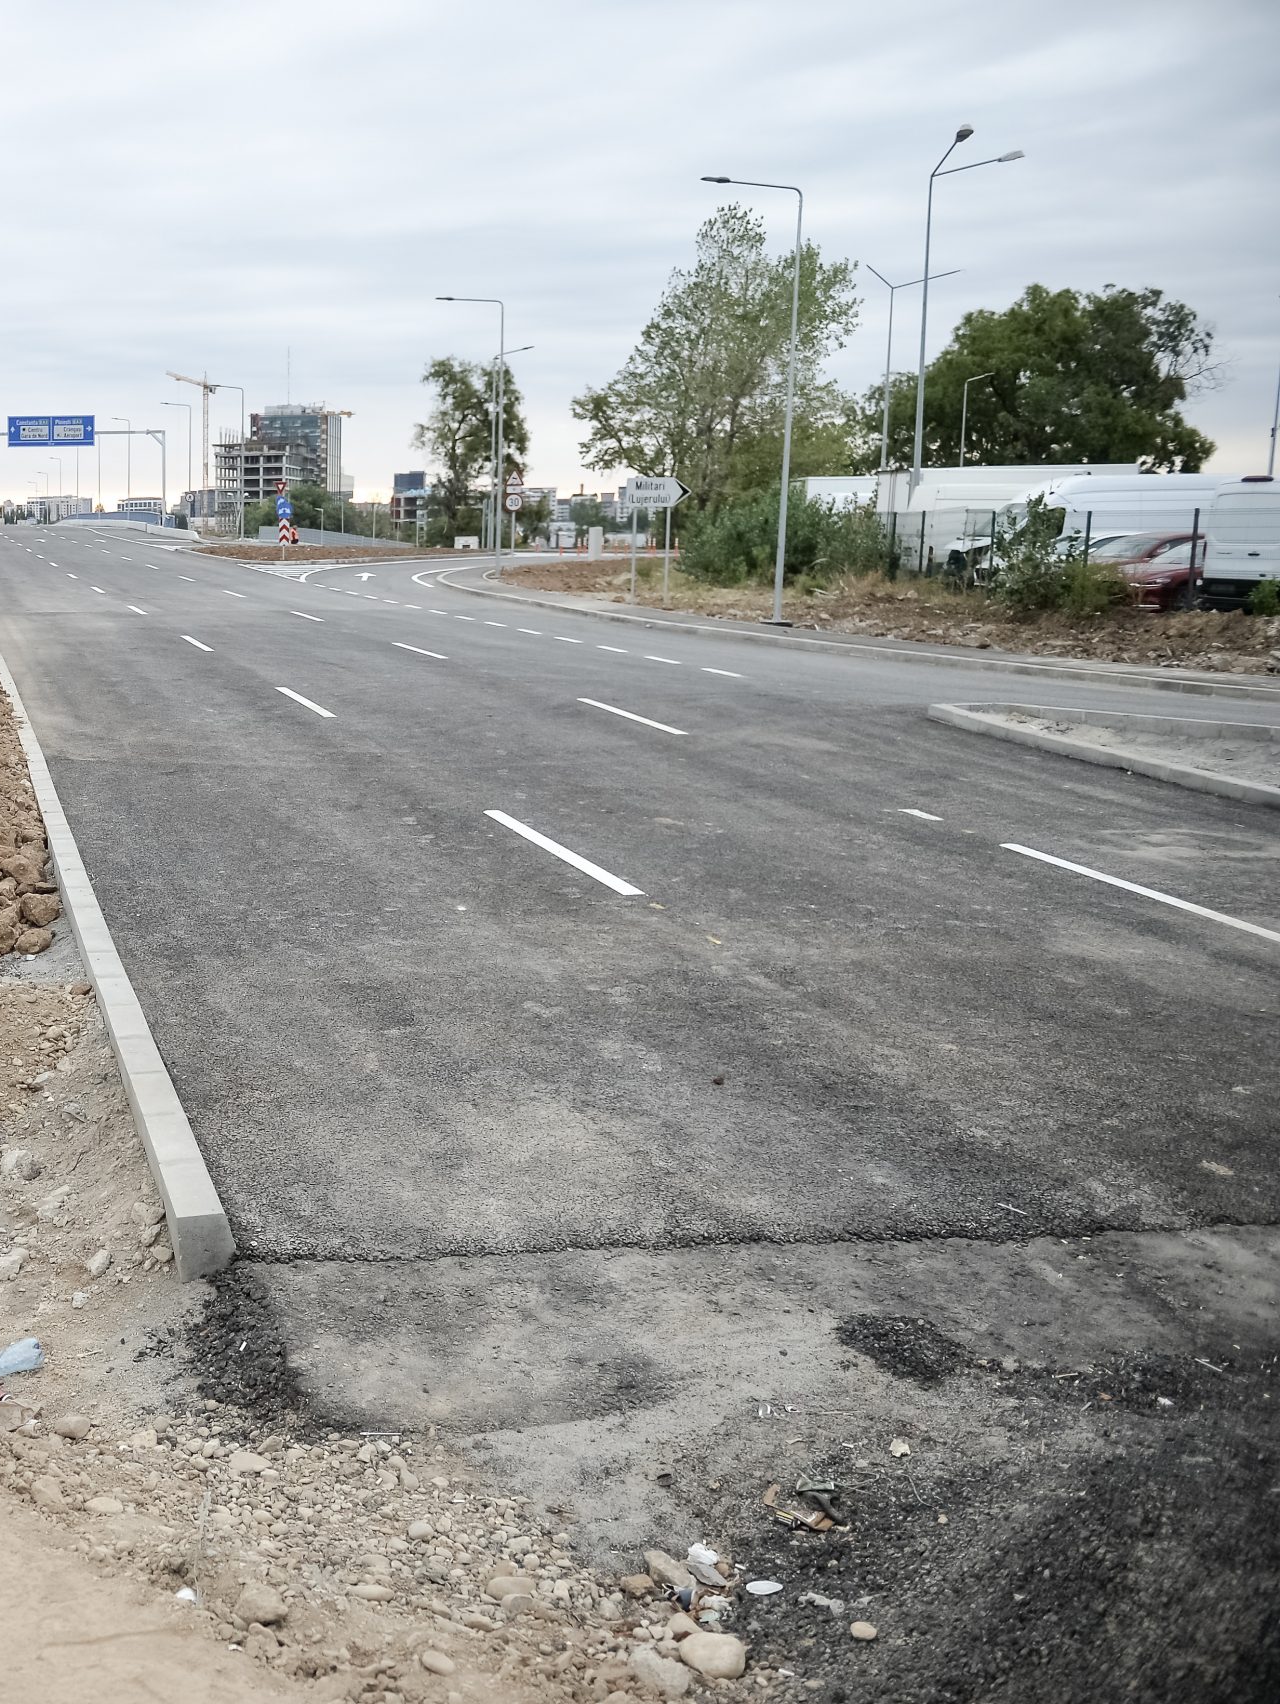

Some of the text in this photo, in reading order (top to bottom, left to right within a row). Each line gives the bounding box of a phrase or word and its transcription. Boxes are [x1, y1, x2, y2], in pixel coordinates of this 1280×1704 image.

[635, 481, 665, 491] Militari
[508, 497, 520, 507] 30
[628, 494, 671, 506] (Lujerului)
